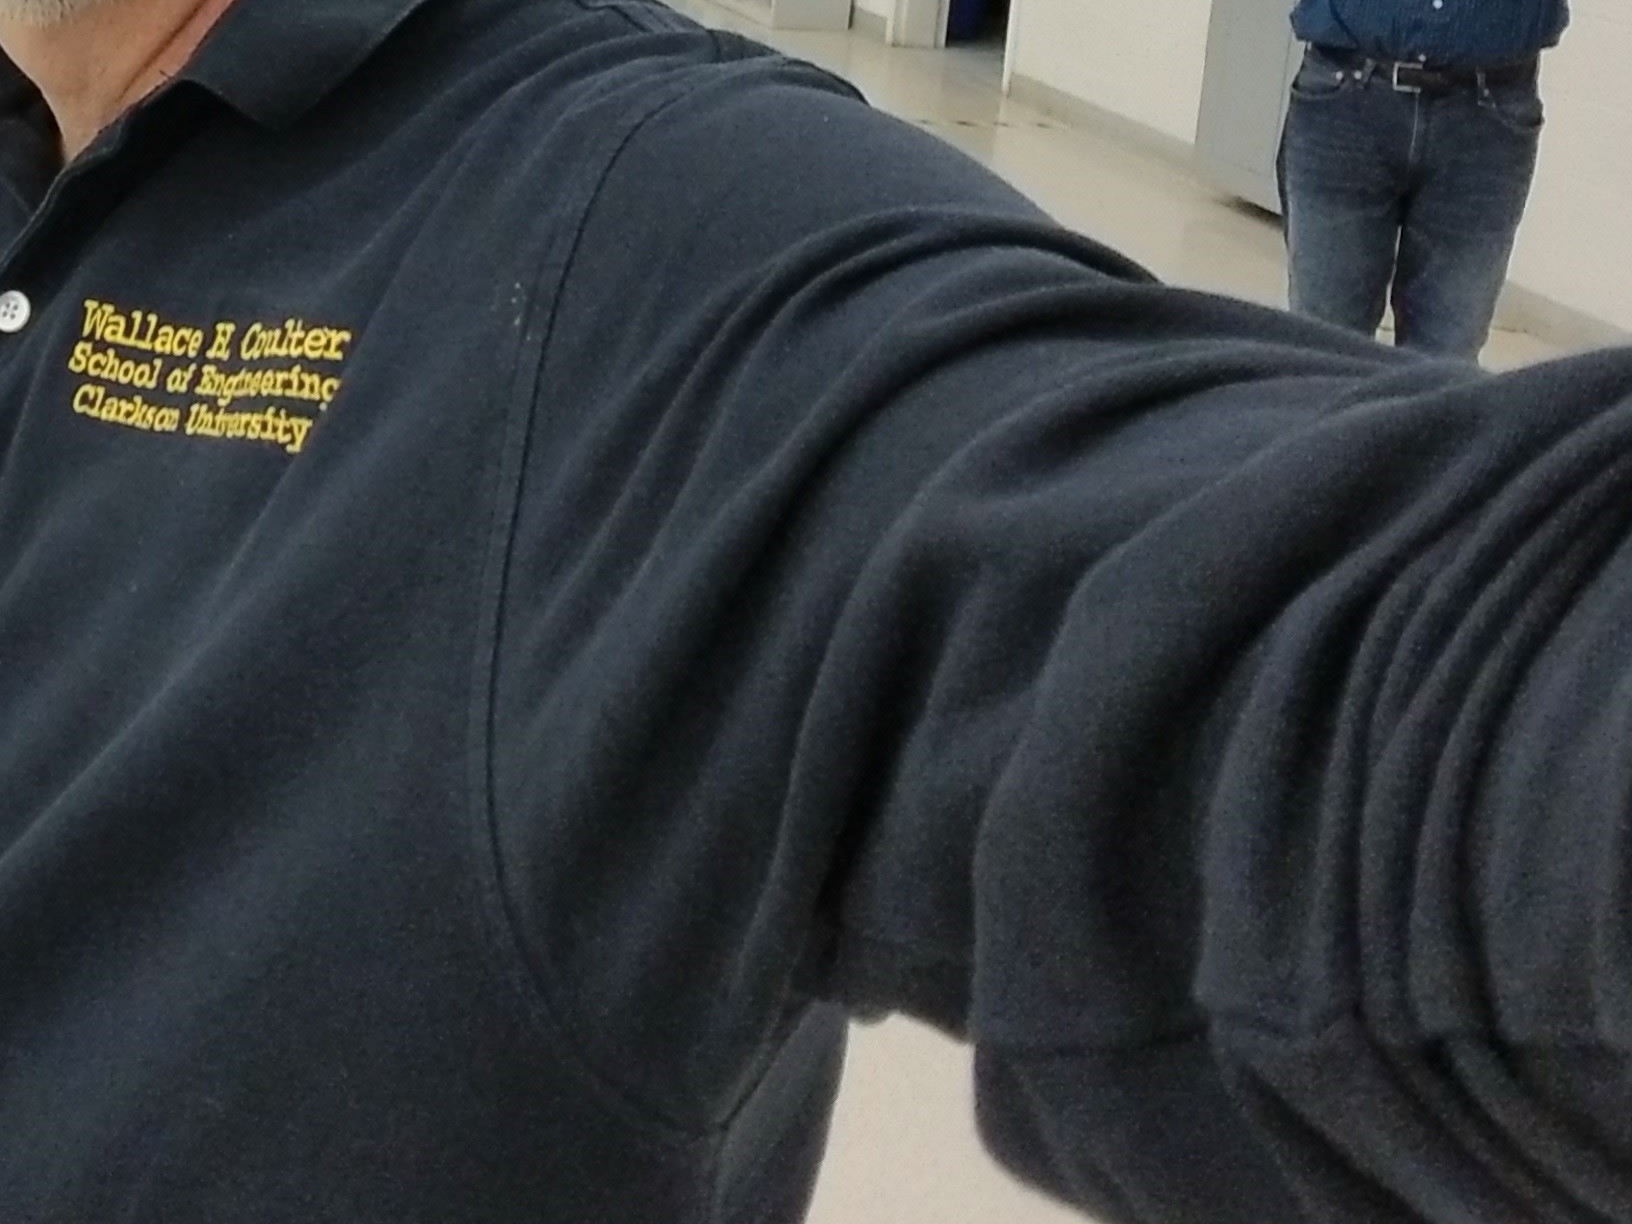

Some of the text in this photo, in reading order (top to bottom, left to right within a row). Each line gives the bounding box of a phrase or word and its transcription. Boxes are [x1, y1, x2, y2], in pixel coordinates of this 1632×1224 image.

[82, 298, 204, 358] Wallace
[240, 318, 352, 361] Coulter
[68, 340, 163, 390] School
[166, 362, 197, 393] of
[72, 383, 313, 453] Clarkson University
